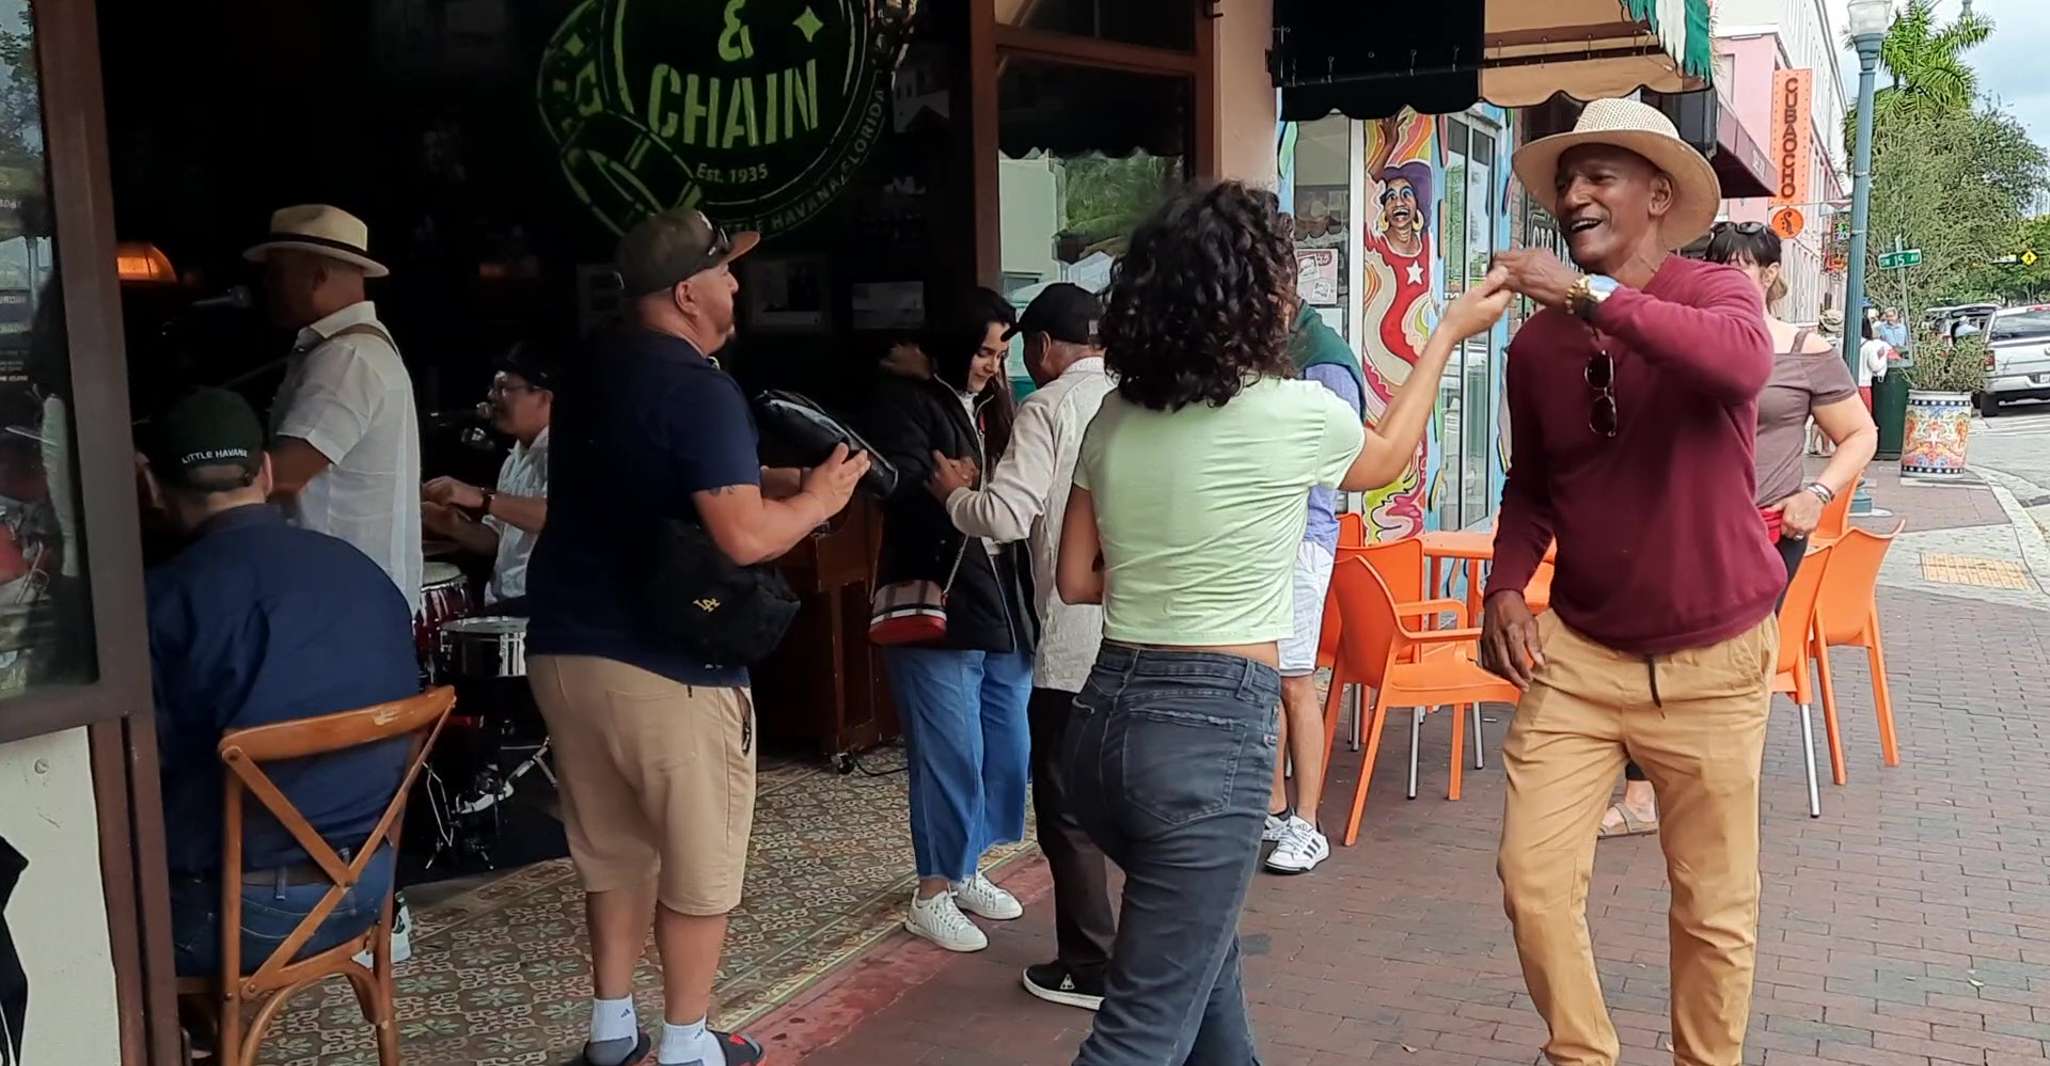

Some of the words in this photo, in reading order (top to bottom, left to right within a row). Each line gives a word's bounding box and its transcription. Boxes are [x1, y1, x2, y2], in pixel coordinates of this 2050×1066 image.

[718, 0, 755, 62] &
[648, 58, 819, 149] CHAIN
[1780, 77, 1800, 199] CUBAOCHO
[696, 162, 724, 184] Est.
[730, 162, 768, 184] 1935
[1894, 254, 1905, 267] 15
[181, 450, 213, 464] LITTLE
[215, 448, 248, 459] HAVANA
[692, 598, 721, 614] LA
